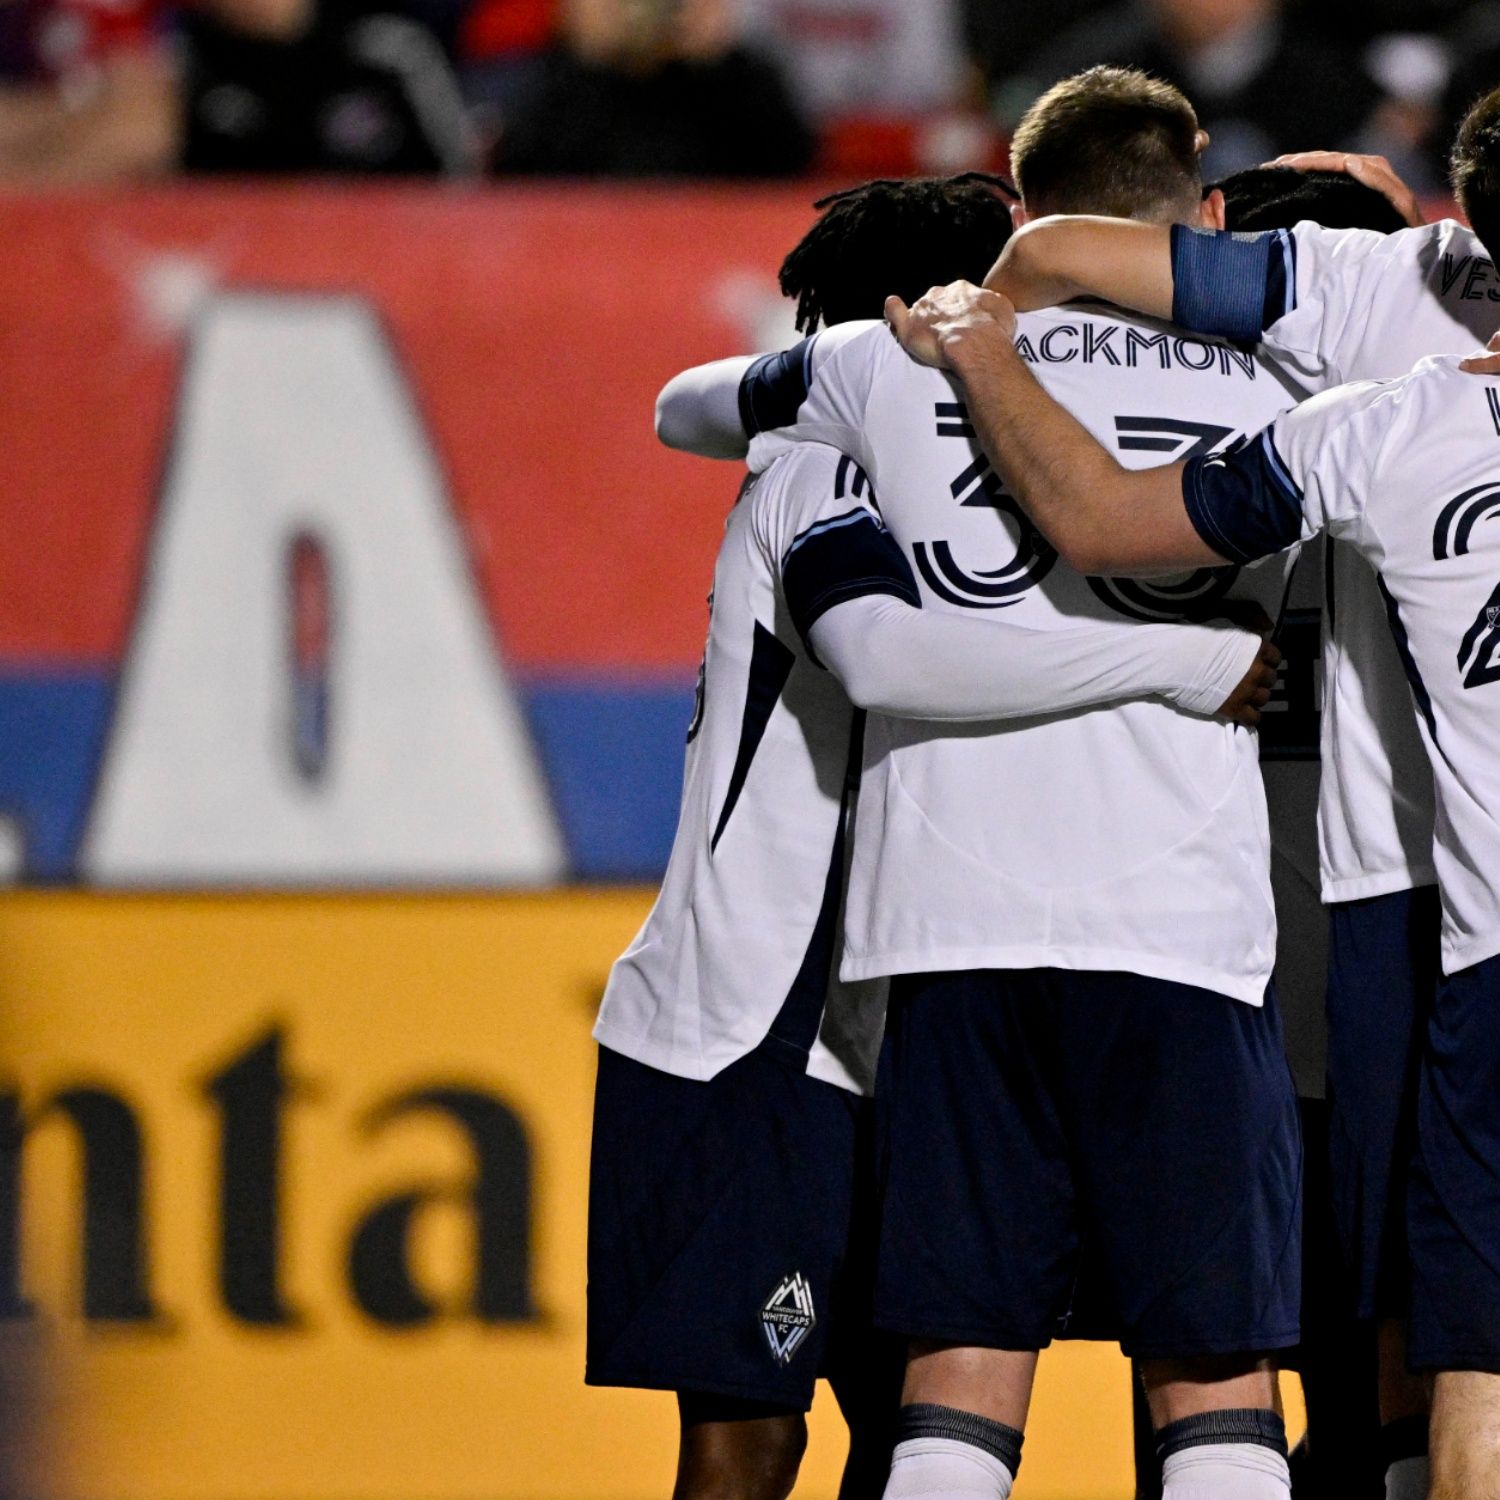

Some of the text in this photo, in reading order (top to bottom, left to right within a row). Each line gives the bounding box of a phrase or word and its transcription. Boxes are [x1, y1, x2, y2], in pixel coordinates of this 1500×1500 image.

[0, 1010, 600, 1330] nta
[762, 1311, 810, 1327] WHITECAPS
[778, 1323, 789, 1334] FC
